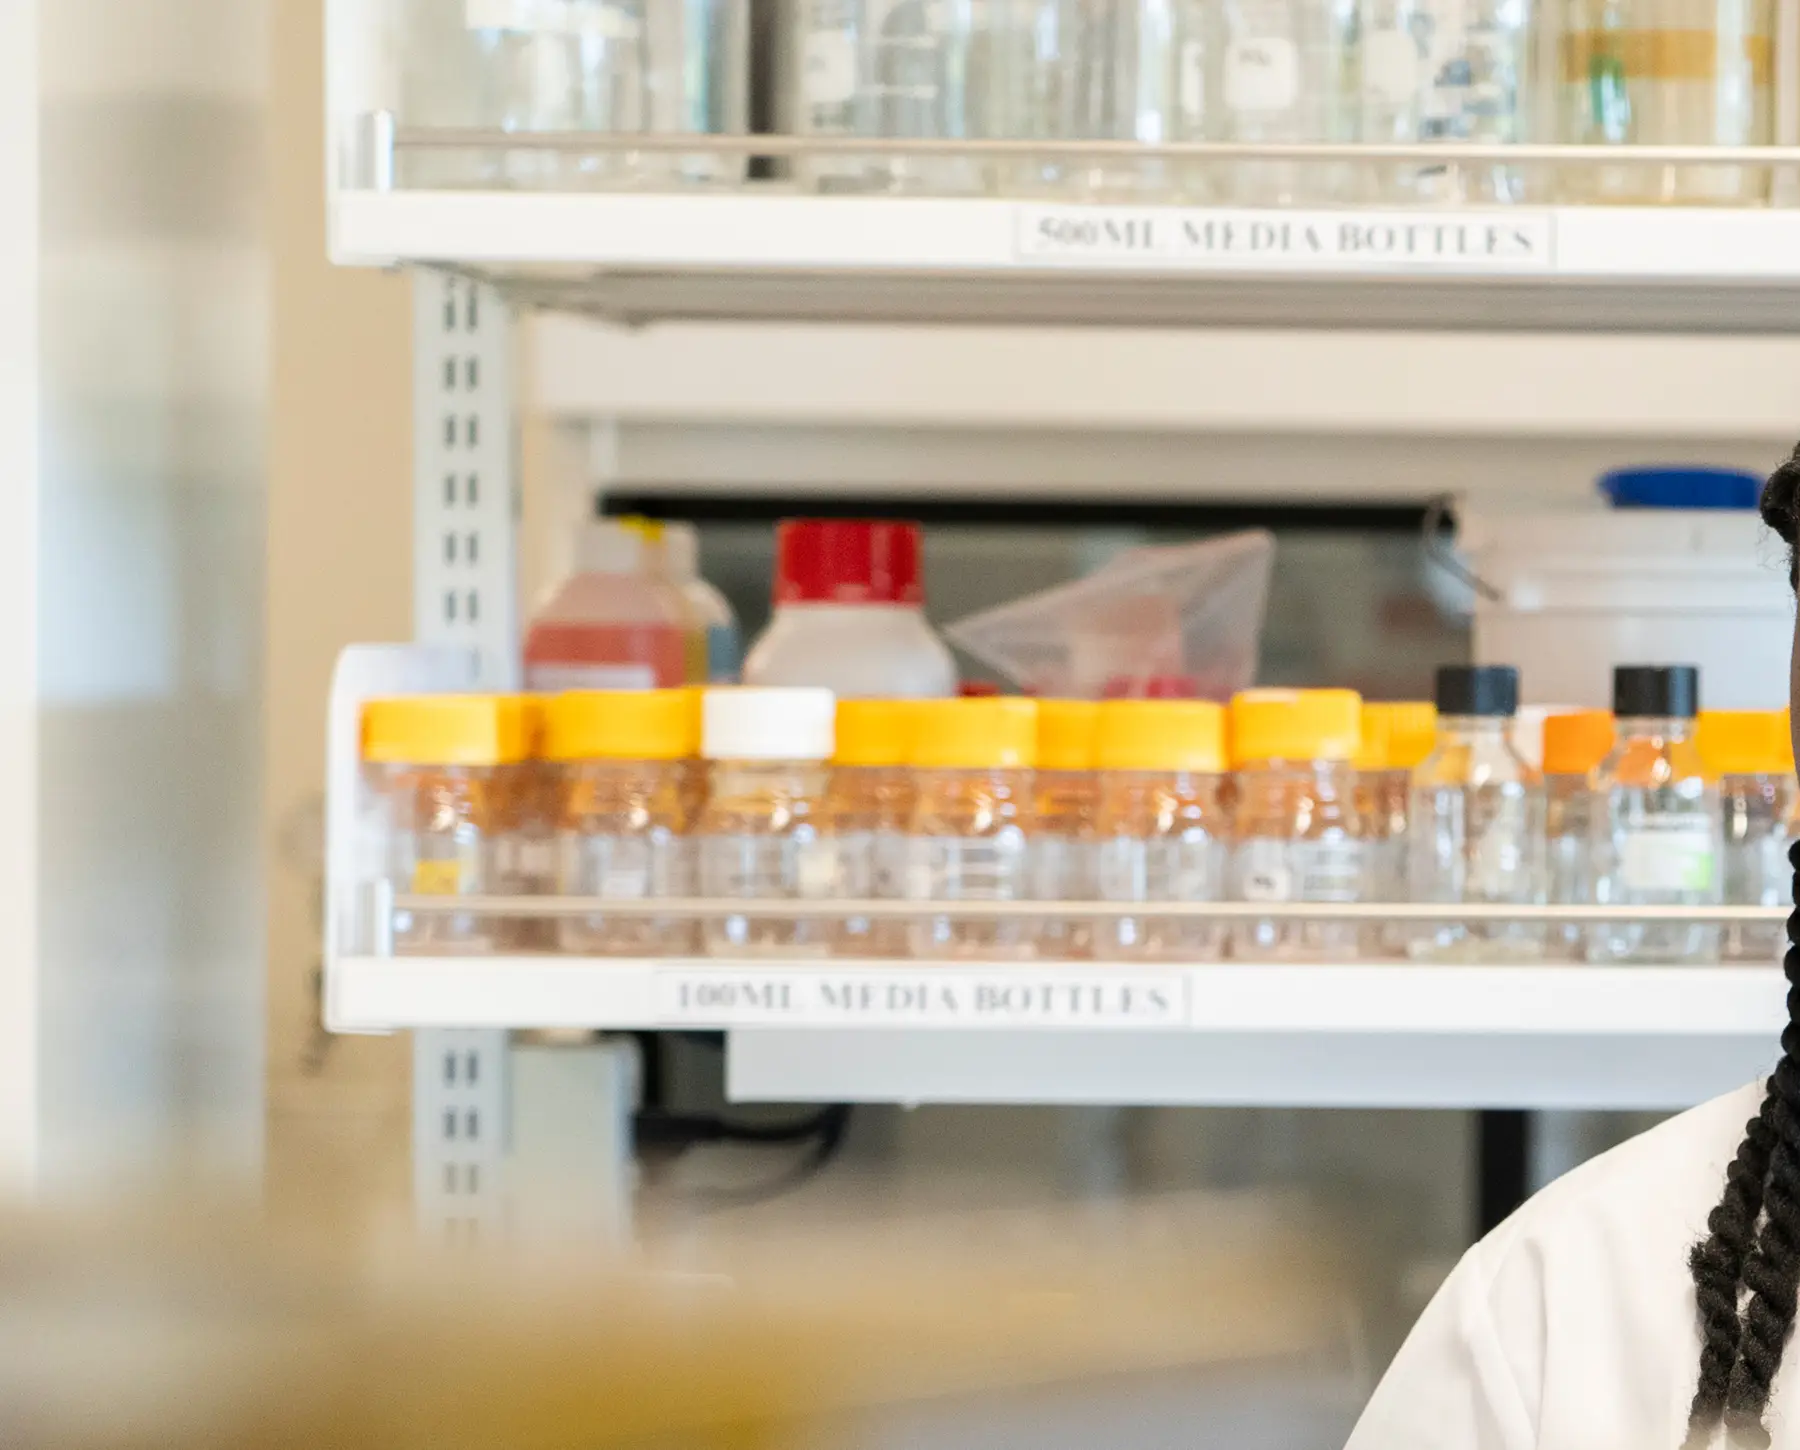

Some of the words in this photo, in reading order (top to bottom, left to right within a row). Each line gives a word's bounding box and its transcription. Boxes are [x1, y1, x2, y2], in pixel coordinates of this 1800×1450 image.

[1037, 216, 1157, 250] 500ML
[1182, 219, 1324, 252] MEDIA
[1336, 222, 1535, 254] BOTTLES
[678, 980, 795, 1012] 100ML
[818, 980, 960, 1014] MEDIA
[974, 982, 1171, 1016] BOTTLES
